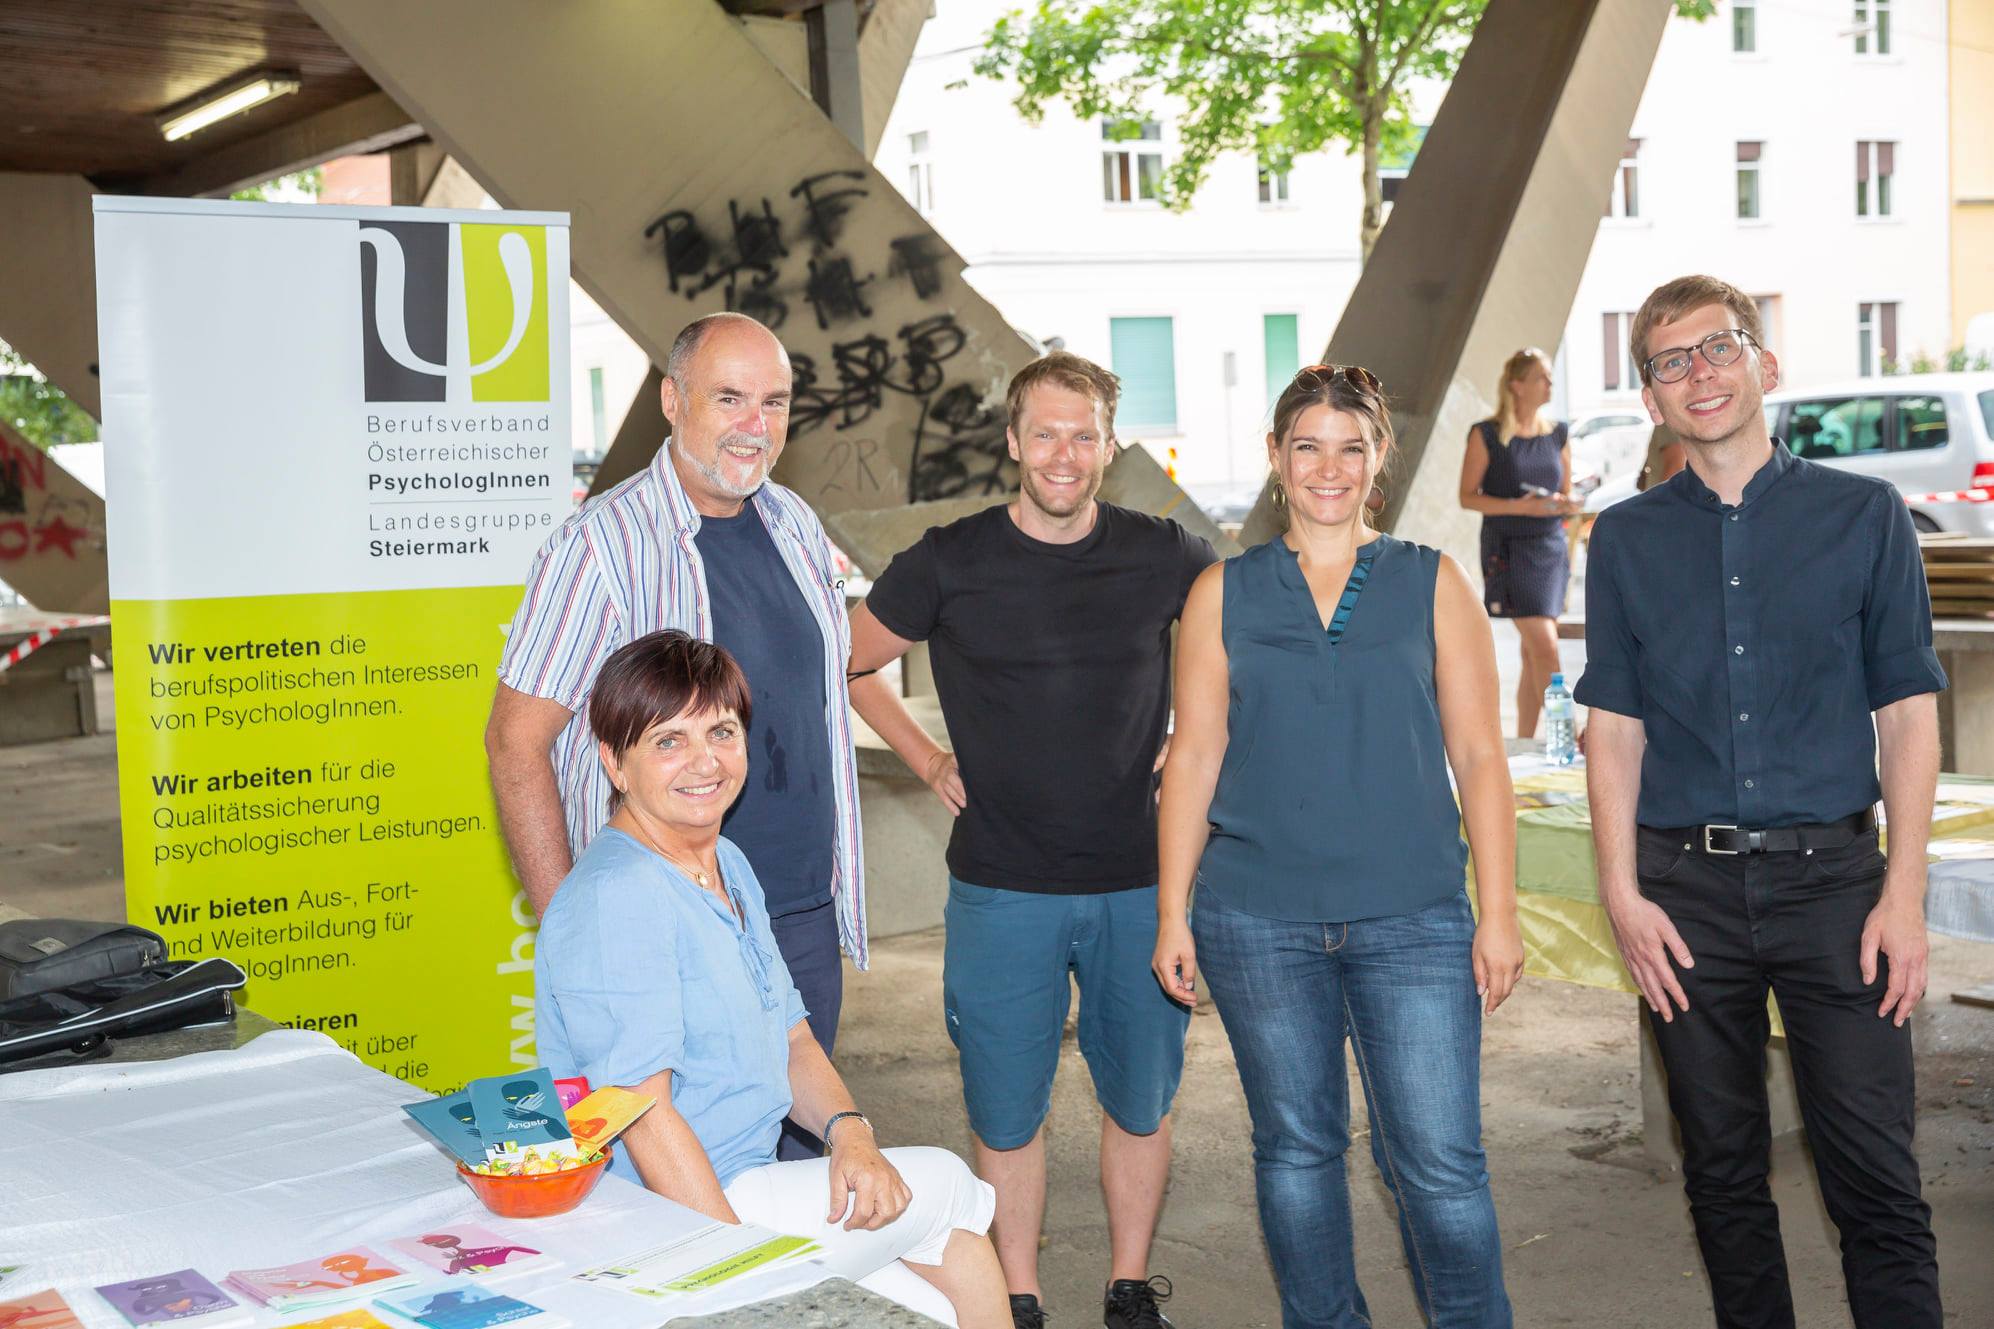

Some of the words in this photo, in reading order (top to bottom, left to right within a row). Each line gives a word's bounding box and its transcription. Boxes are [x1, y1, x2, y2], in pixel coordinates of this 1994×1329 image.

[367, 415, 549, 433] Berufsverband
[367, 441, 549, 463] Österreichischer
[368, 472, 550, 495] PsychologInnen
[369, 511, 553, 533] Landesgruppe
[369, 537, 490, 557] Steiermark
[148, 643, 196, 664] Wir
[203, 638, 321, 662] vertreten
[331, 635, 366, 655] die
[151, 668, 355, 698] berufspolitischen
[365, 663, 479, 684] Interessen
[151, 713, 196, 731] von
[205, 697, 402, 730] PsychologInnen.
[152, 775, 198, 796] Wir
[207, 767, 312, 792] arbeiten
[321, 762, 352, 782] für
[361, 759, 396, 780] die
[153, 792, 381, 830] Qualitätssicherung
[154, 825, 351, 866] psychologischer
[360, 816, 486, 842] Leistungen.
[155, 903, 200, 925] Wir
[210, 896, 289, 920] bieten
[297, 890, 357, 911] Aus-,
[368, 882, 419, 904] Fort-
[210, 915, 376, 952] Weiterbildung
[385, 911, 414, 932] für
[367, 1034, 417, 1056] über
[395, 1060, 429, 1081] die
[506, 1119, 549, 1130] Ängste
